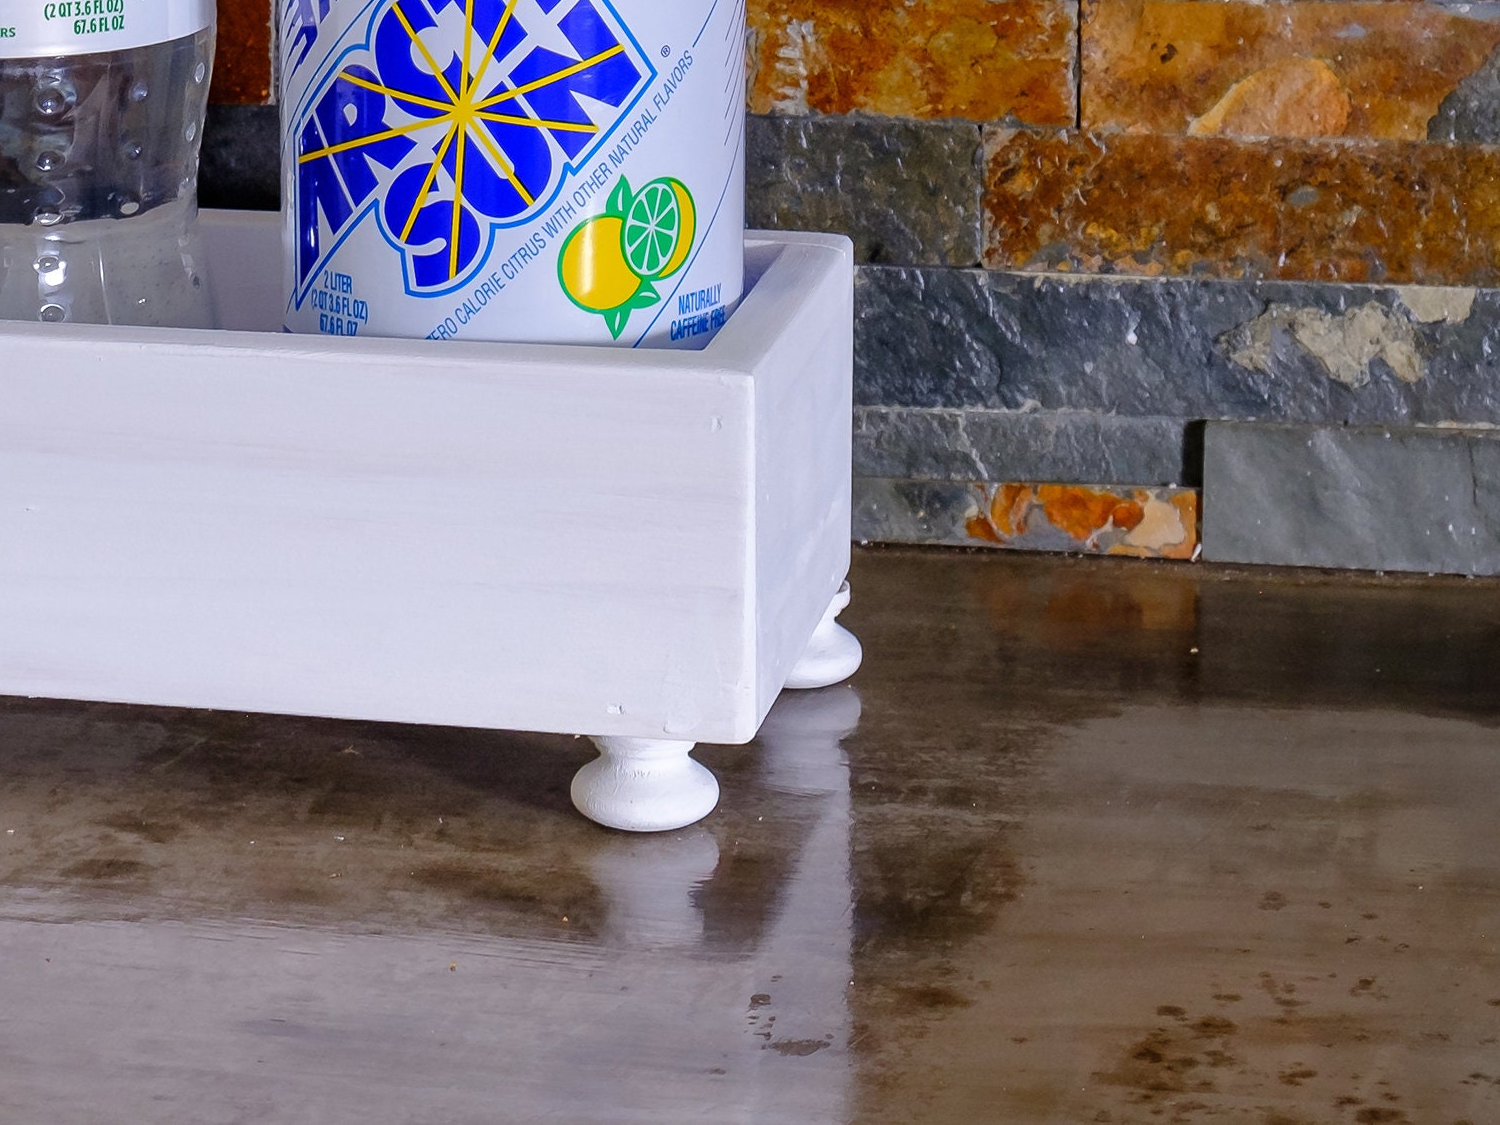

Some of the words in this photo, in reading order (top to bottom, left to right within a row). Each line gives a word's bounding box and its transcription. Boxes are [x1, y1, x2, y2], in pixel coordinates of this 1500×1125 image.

[44, 3, 56, 21] (2
[57, 1, 72, 17] QT
[74, 0, 91, 17] 3.6
[93, 0, 105, 15] FL
[73, 19, 97, 36] 67.6
[98, 18, 110, 33] FL
[111, 15, 125, 31] OZ
[454, 271, 506, 325] CALORIE
[501, 232, 546, 281] CITRUS
[544, 200, 577, 238] WITH
[572, 168, 613, 208] OTHER
[608, 110, 657, 170] NATURAL
[652, 50, 694, 113] FLAVORS
[324, 269, 329, 289] 2
[330, 271, 352, 295] LITER
[329, 293, 341, 315] 3.6
[342, 296, 352, 317] FL
[678, 283, 722, 315] NATURALLY
[670, 312, 709, 341] CAFFEINE
